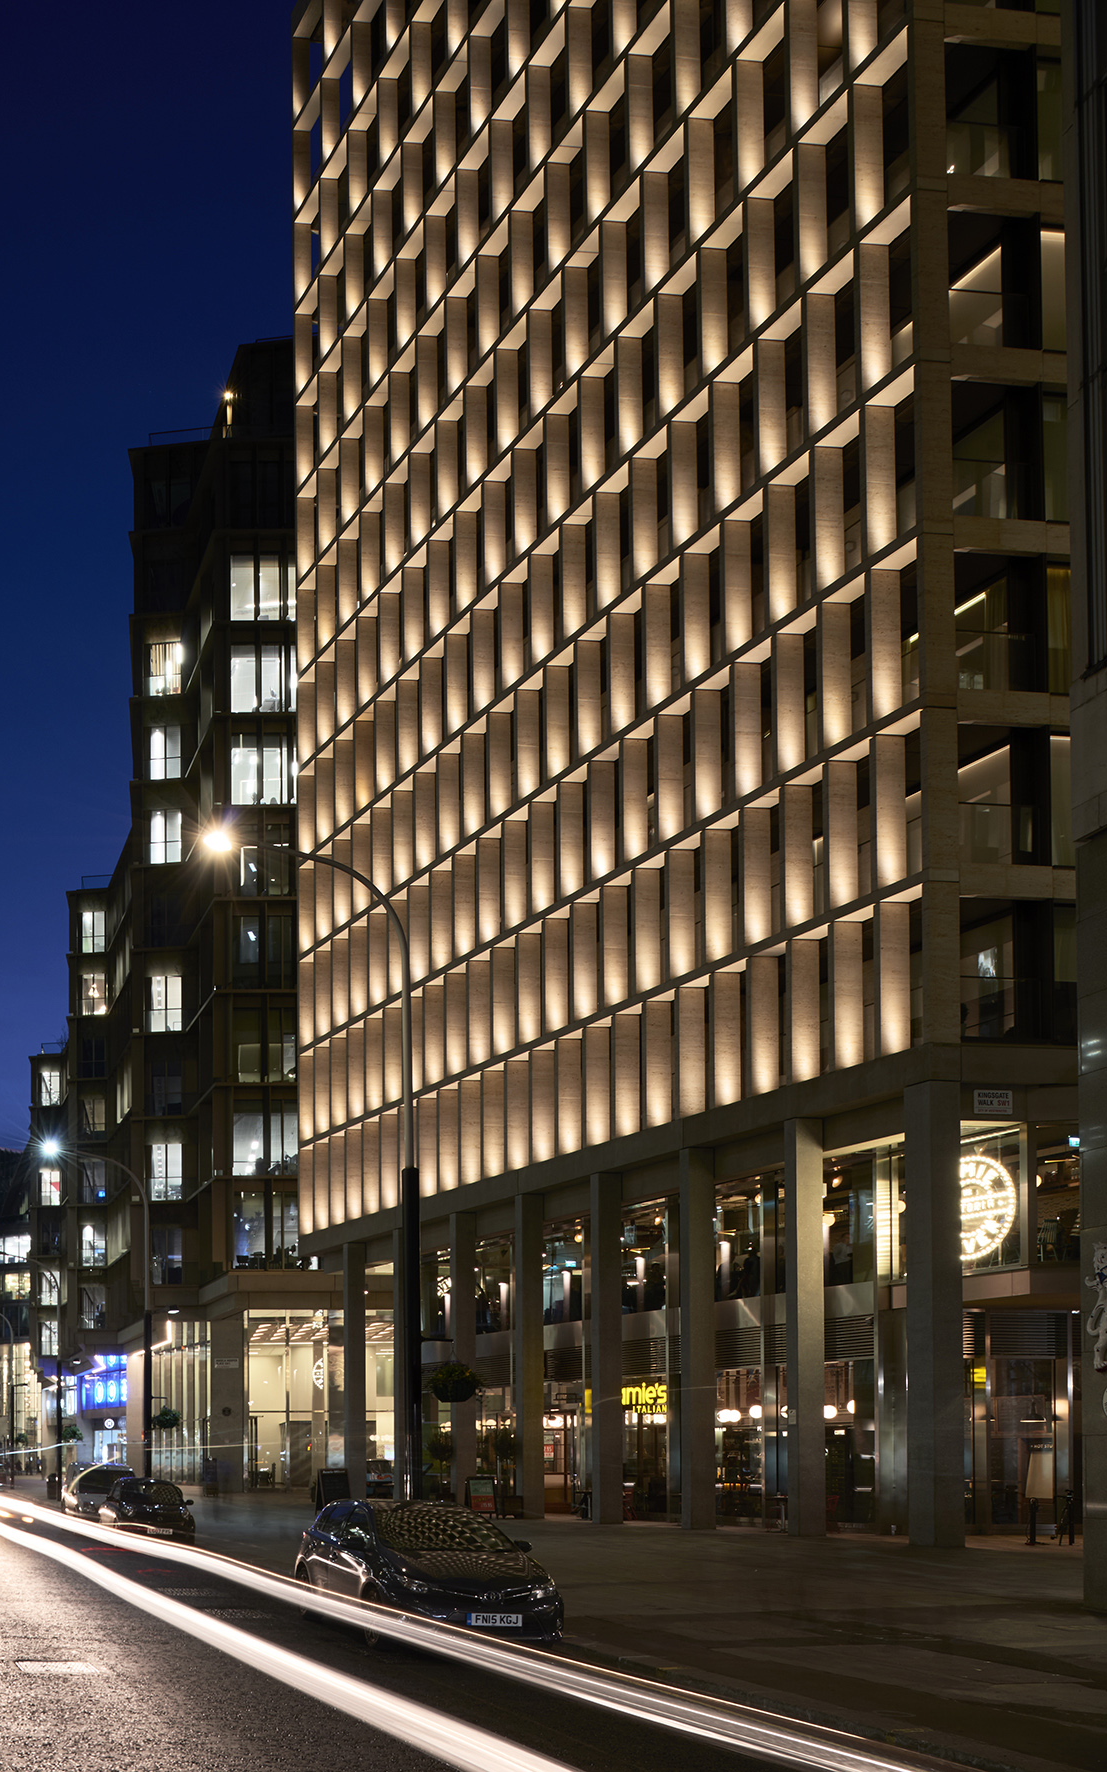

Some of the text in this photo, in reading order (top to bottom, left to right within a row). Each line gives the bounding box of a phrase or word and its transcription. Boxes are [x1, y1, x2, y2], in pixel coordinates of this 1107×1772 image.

[960, 1199, 994, 1213] TORIA
[632, 1405, 667, 1413] ITALIAN
[475, 1614, 519, 1625] FN15 KGJ
